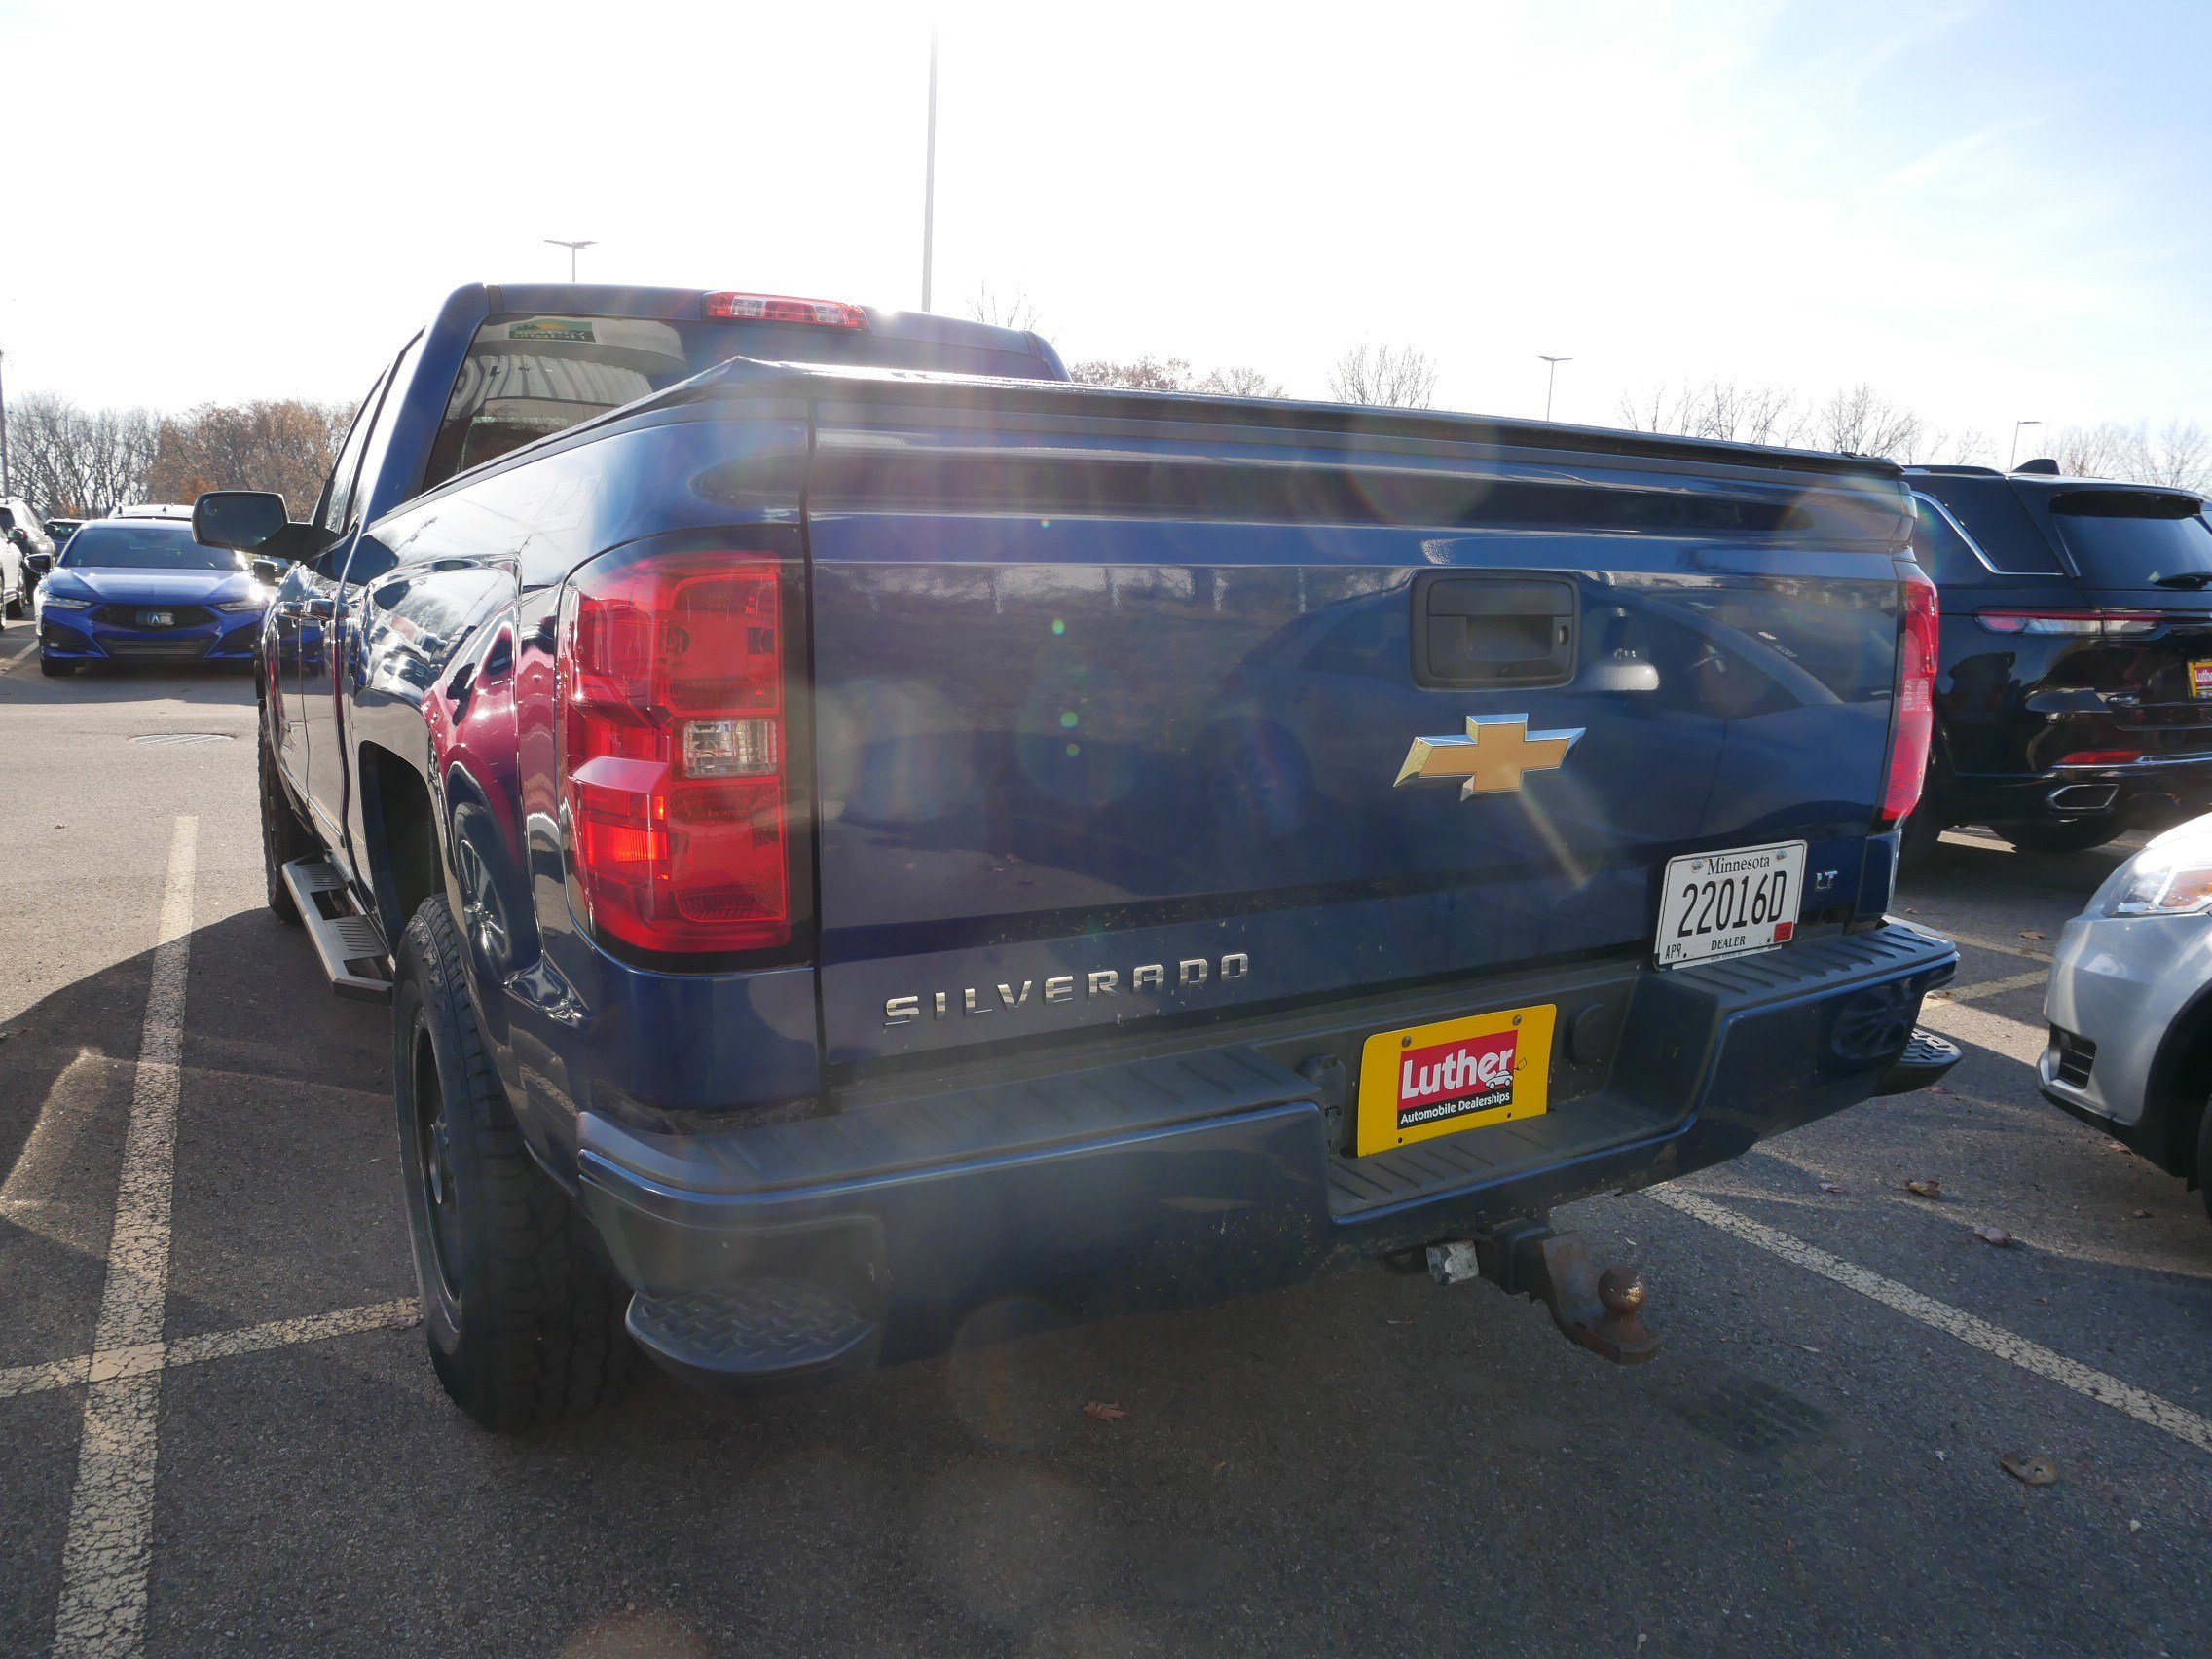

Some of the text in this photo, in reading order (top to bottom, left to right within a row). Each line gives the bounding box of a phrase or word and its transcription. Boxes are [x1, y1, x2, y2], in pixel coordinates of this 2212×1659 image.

[1707, 855, 1770, 876] Minnesota
[1815, 870, 1838, 890] LT
[1677, 870, 1788, 938] 22016D
[1665, 943, 1682, 960] APR
[1711, 936, 1746, 951] DEALER
[884, 953, 1249, 1026] SILVERADO
[1401, 1048, 1514, 1100] Luther
[1400, 1091, 1510, 1124] Automobile Dealerships
